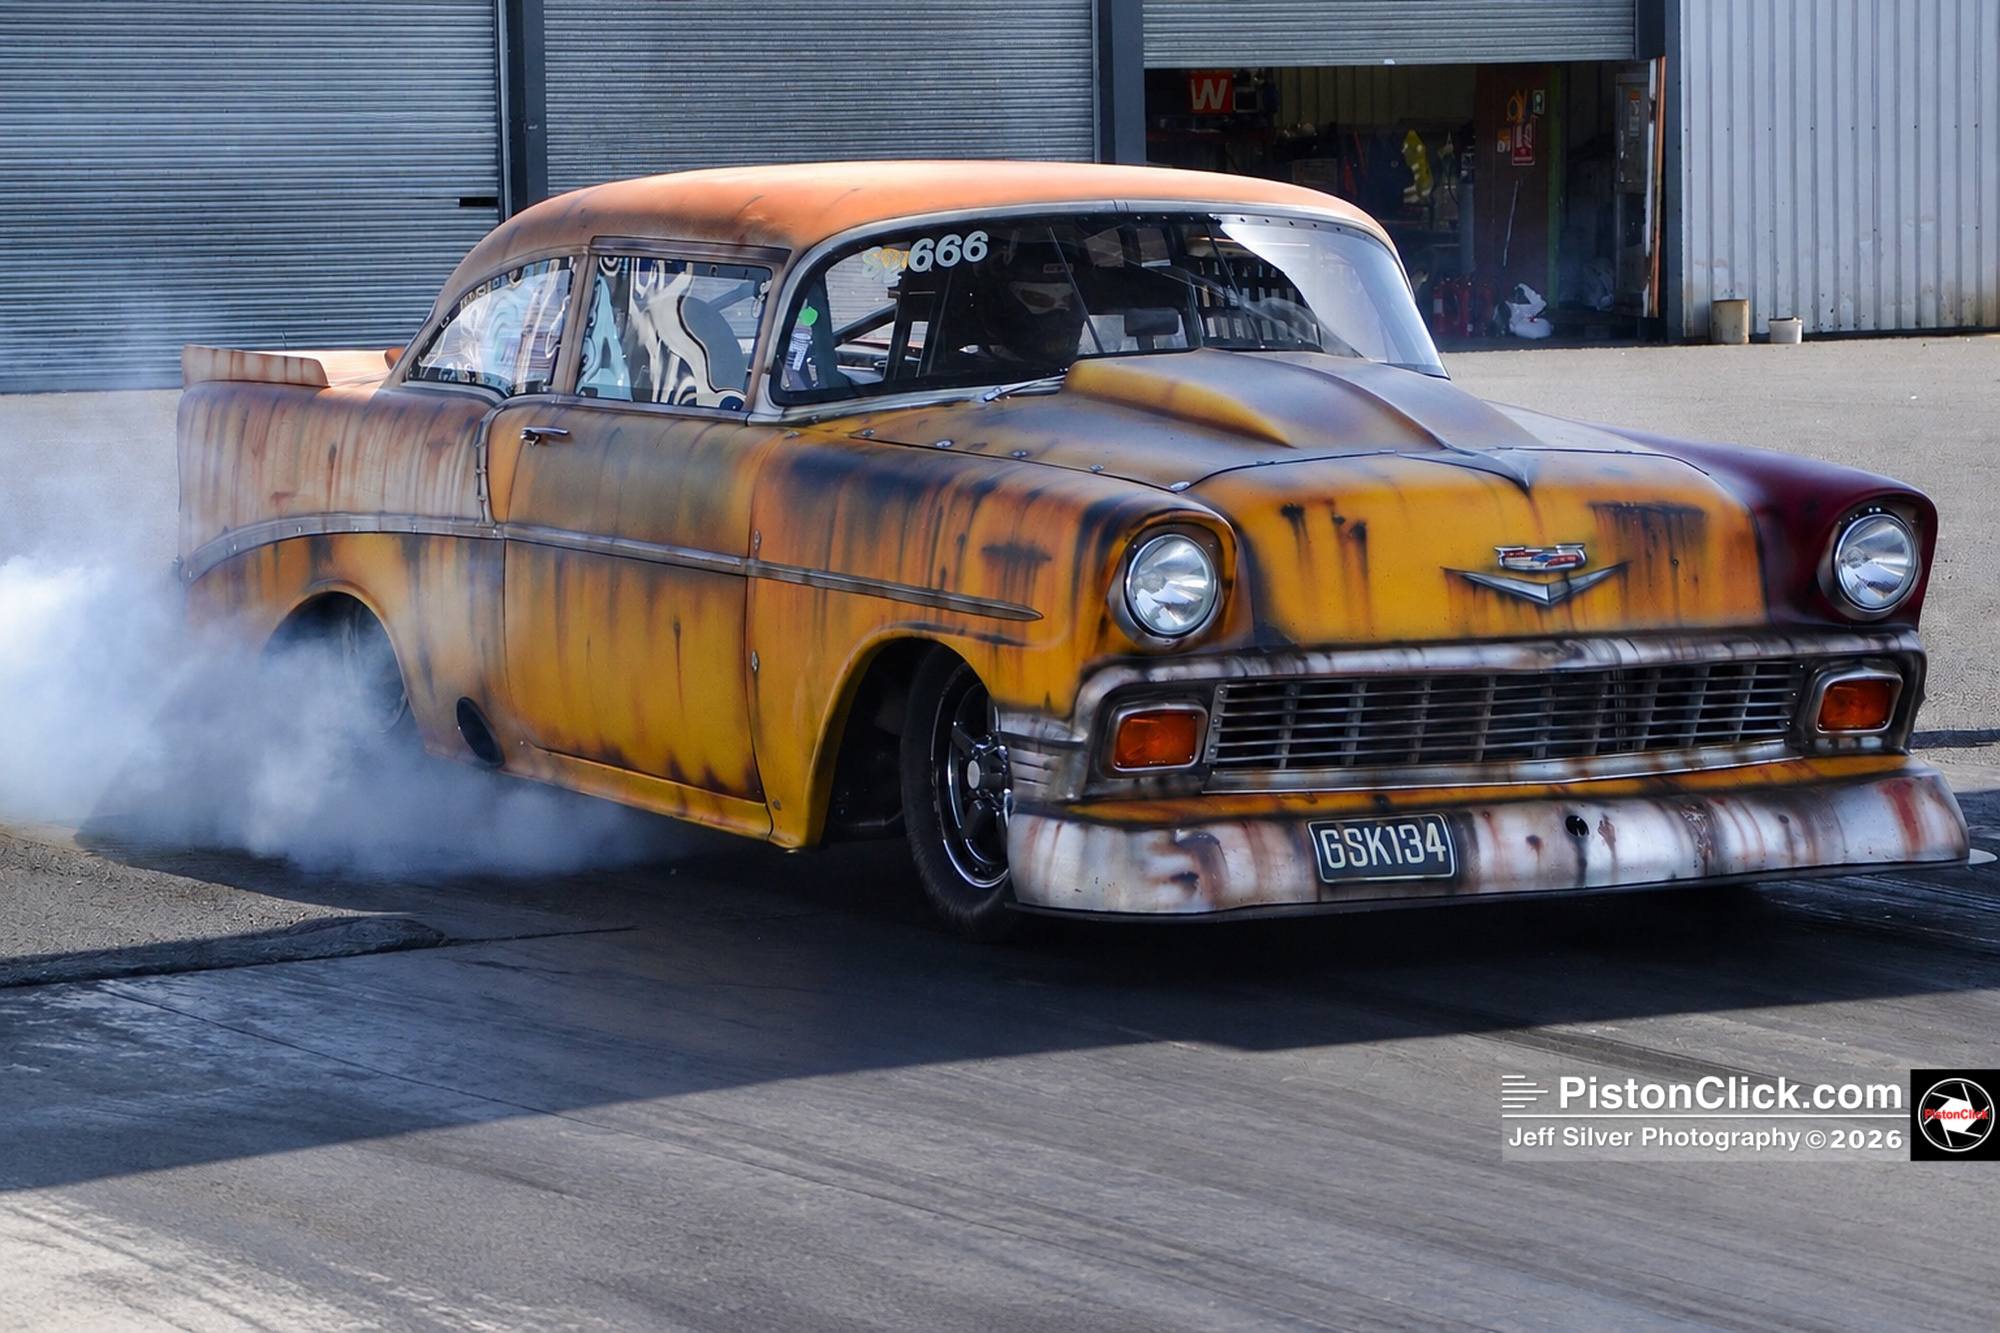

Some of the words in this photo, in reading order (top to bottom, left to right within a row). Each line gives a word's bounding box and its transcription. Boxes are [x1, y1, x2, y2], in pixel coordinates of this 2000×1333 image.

[1190, 78, 1228, 110] W
[908, 230, 989, 273] 666
[1319, 822, 1447, 869] GSK134
